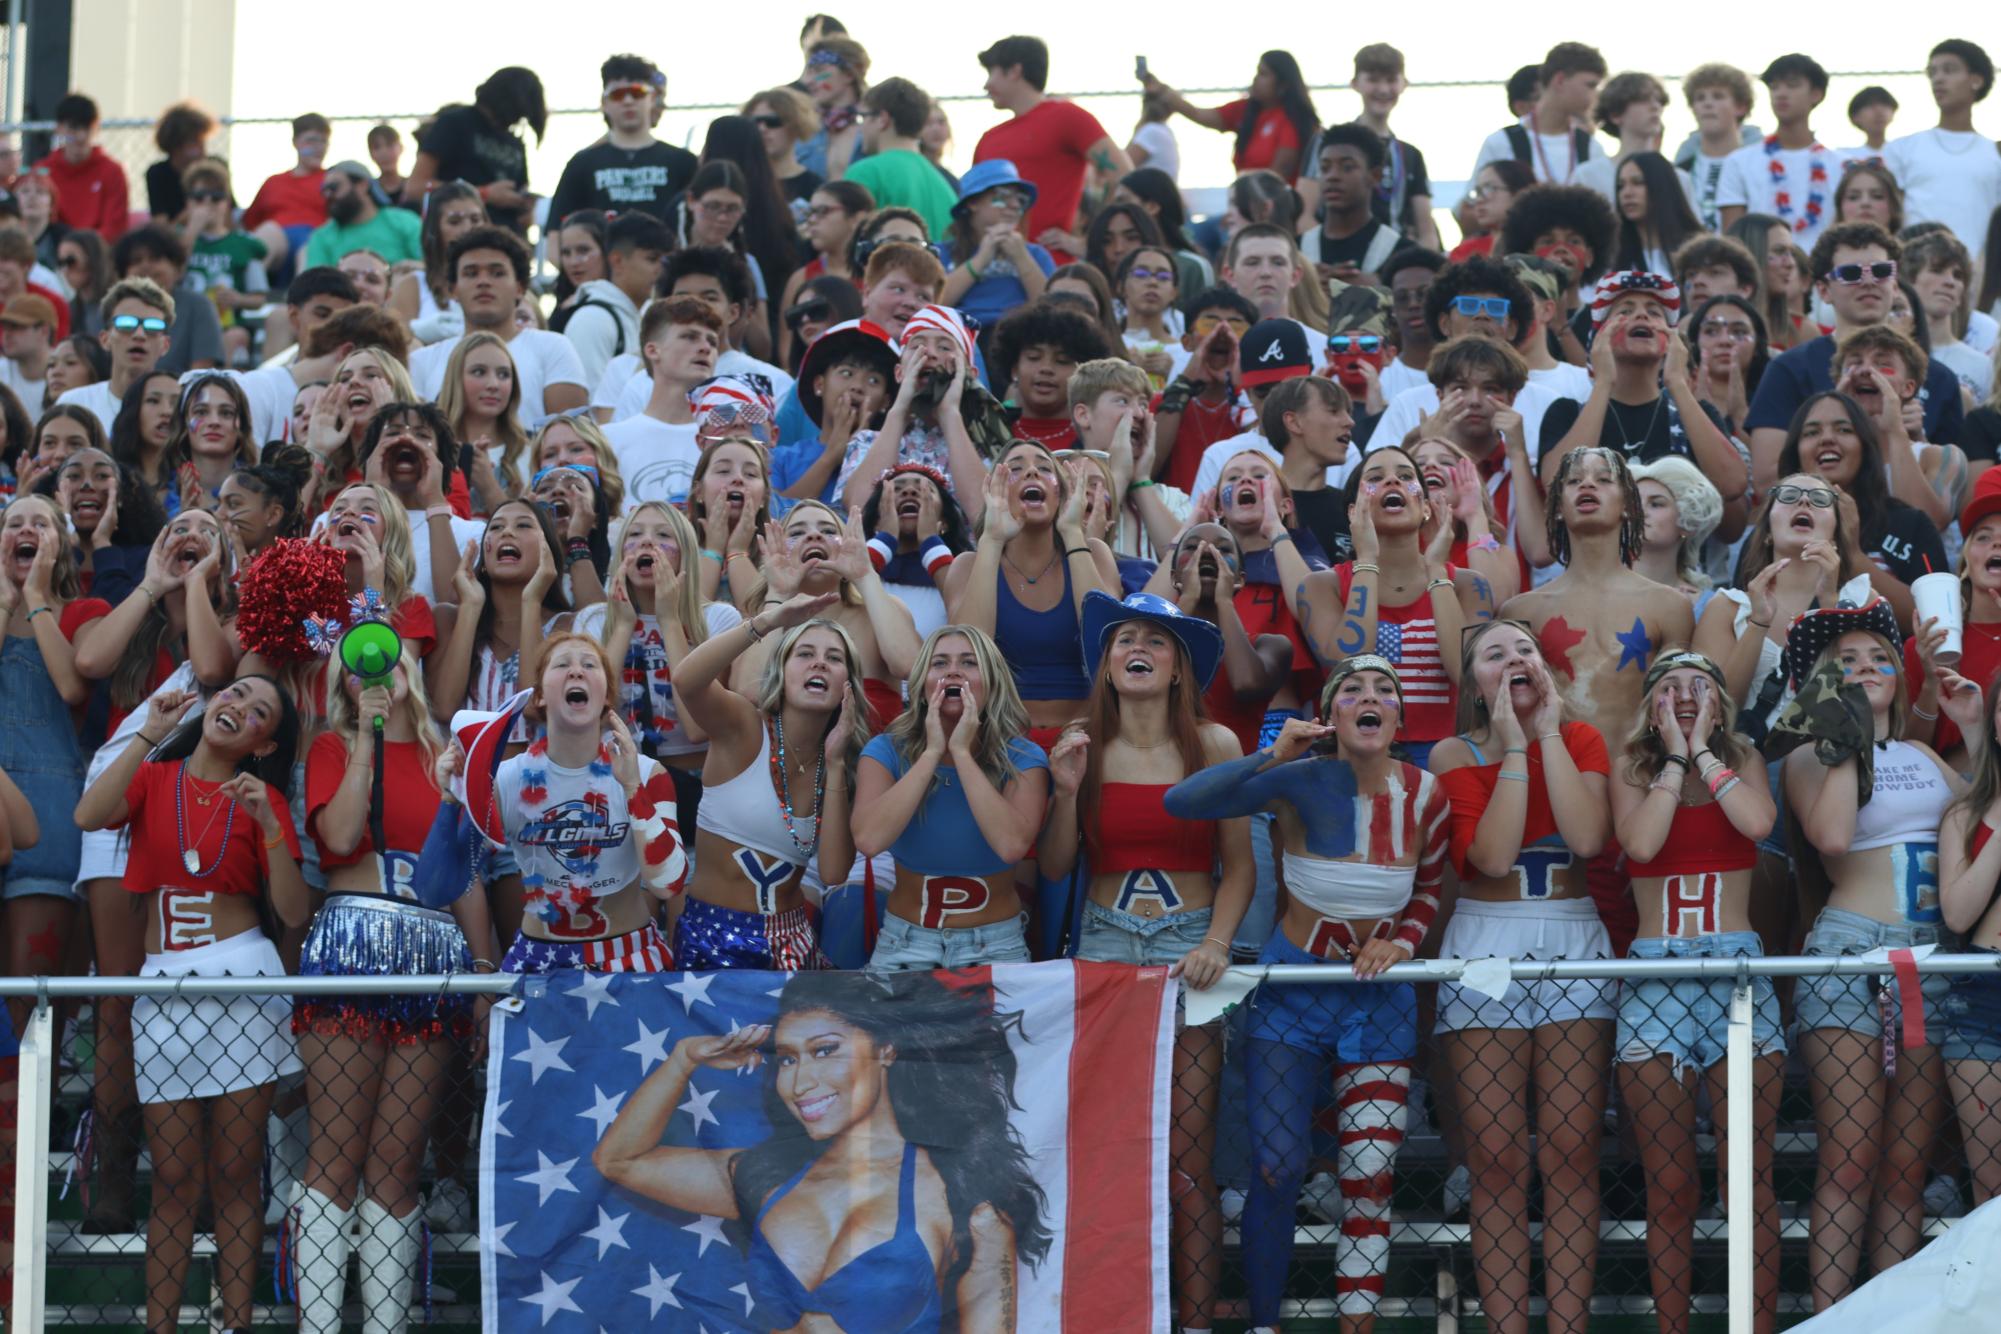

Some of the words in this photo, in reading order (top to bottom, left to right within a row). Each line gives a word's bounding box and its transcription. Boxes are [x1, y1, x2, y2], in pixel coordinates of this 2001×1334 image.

[1259, 338, 1285, 362] A
[1873, 773, 1919, 783] HOME
[1874, 766, 1899, 774] AKE
[1902, 763, 1922, 773] ME
[1874, 779, 1936, 792] OWBOY
[732, 847, 796, 915] Y
[1112, 868, 1185, 913] A
[1511, 846, 1574, 900] T
[159, 886, 217, 952] E
[920, 875, 990, 930] P
[1662, 871, 1723, 938] H
